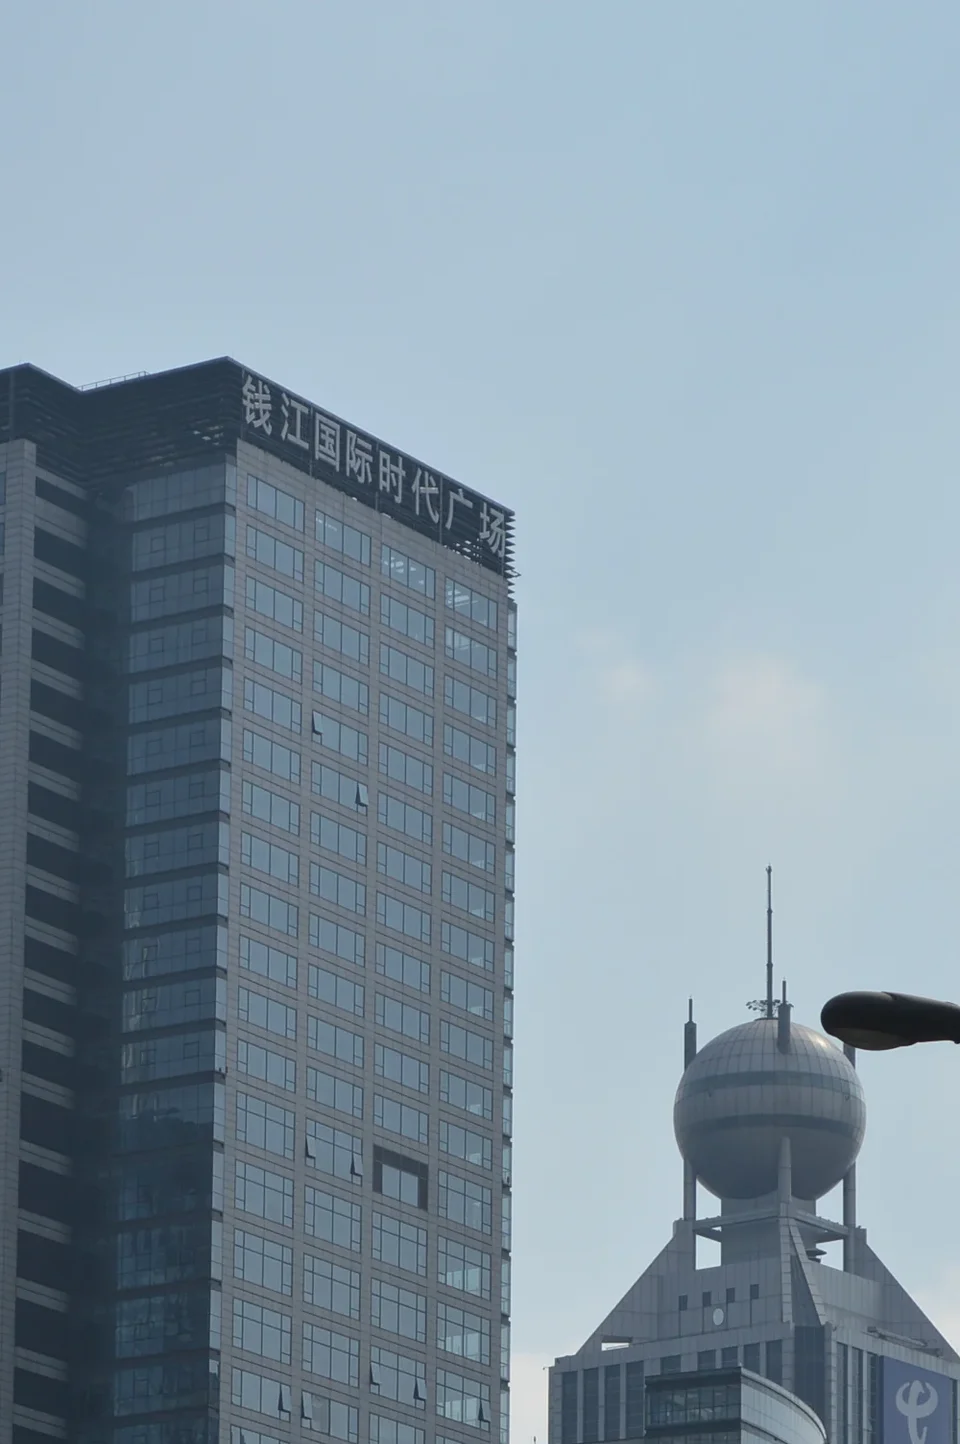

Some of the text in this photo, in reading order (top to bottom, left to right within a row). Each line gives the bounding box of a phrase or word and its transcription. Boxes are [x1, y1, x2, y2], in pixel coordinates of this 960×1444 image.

[242, 376, 505, 558] 钱江国际时代广场
